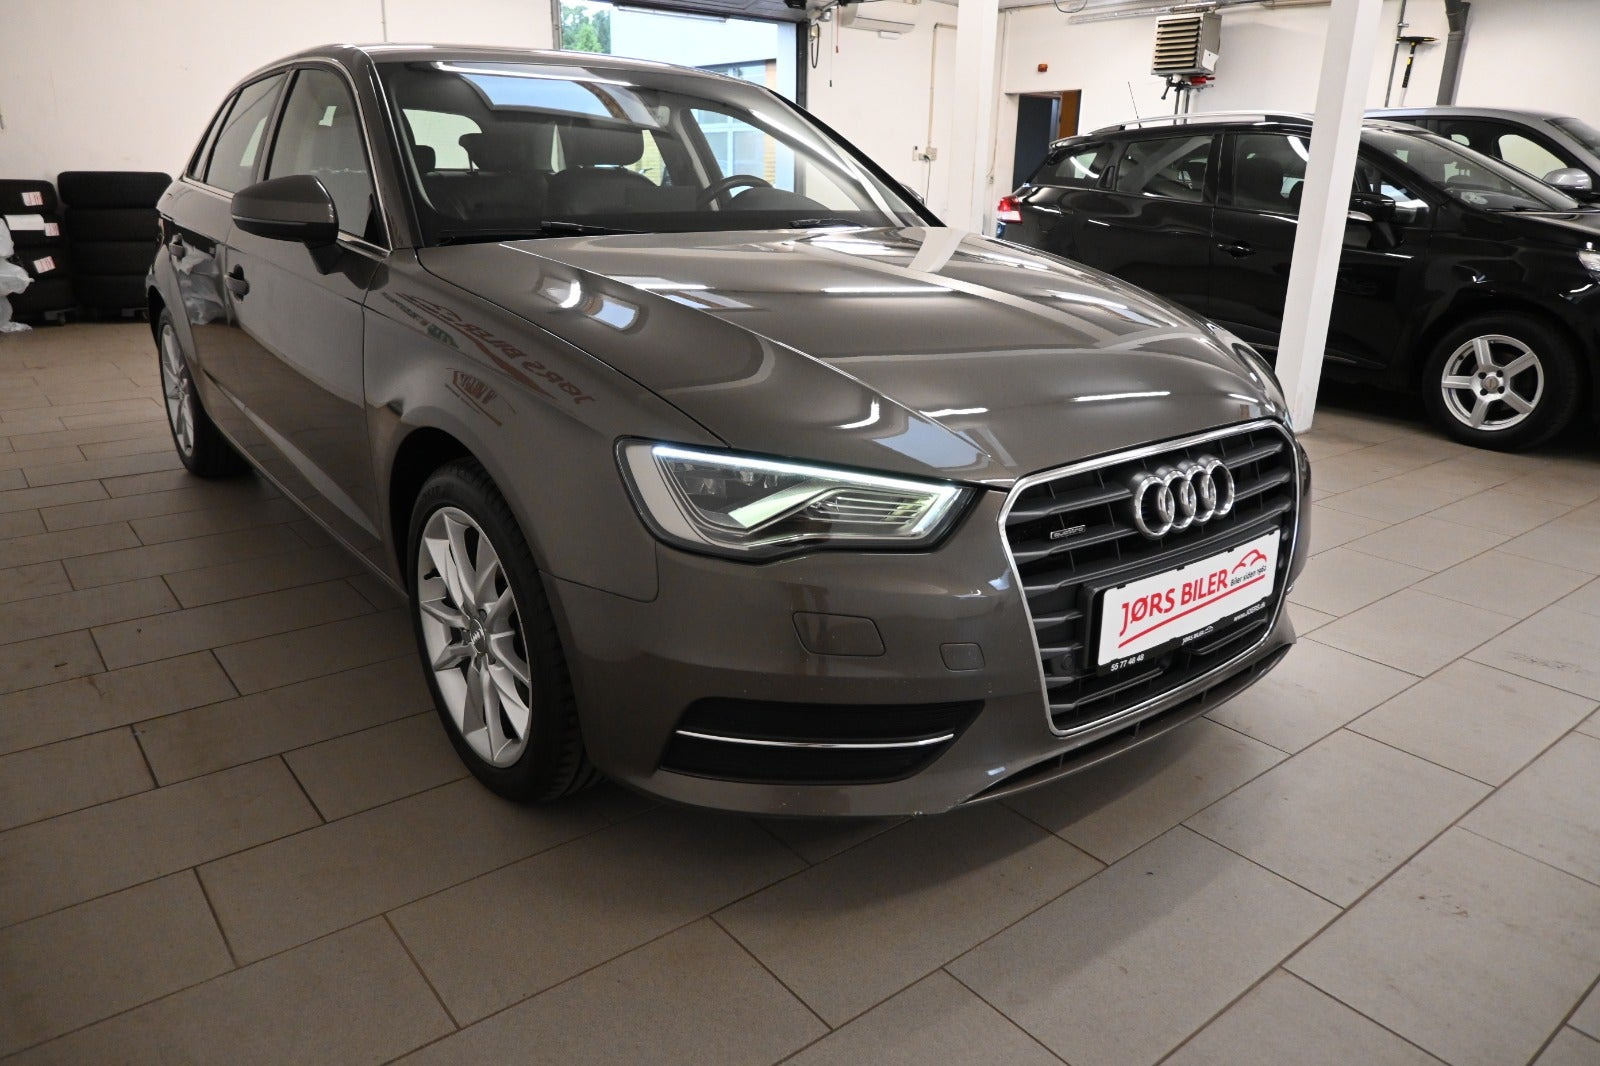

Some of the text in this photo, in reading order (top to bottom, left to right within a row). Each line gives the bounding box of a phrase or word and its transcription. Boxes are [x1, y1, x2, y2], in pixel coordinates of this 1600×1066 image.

[1119, 568, 1228, 637] JØRS BILER
[1110, 662, 1119, 672] 55
[1119, 659, 1128, 669] 77
